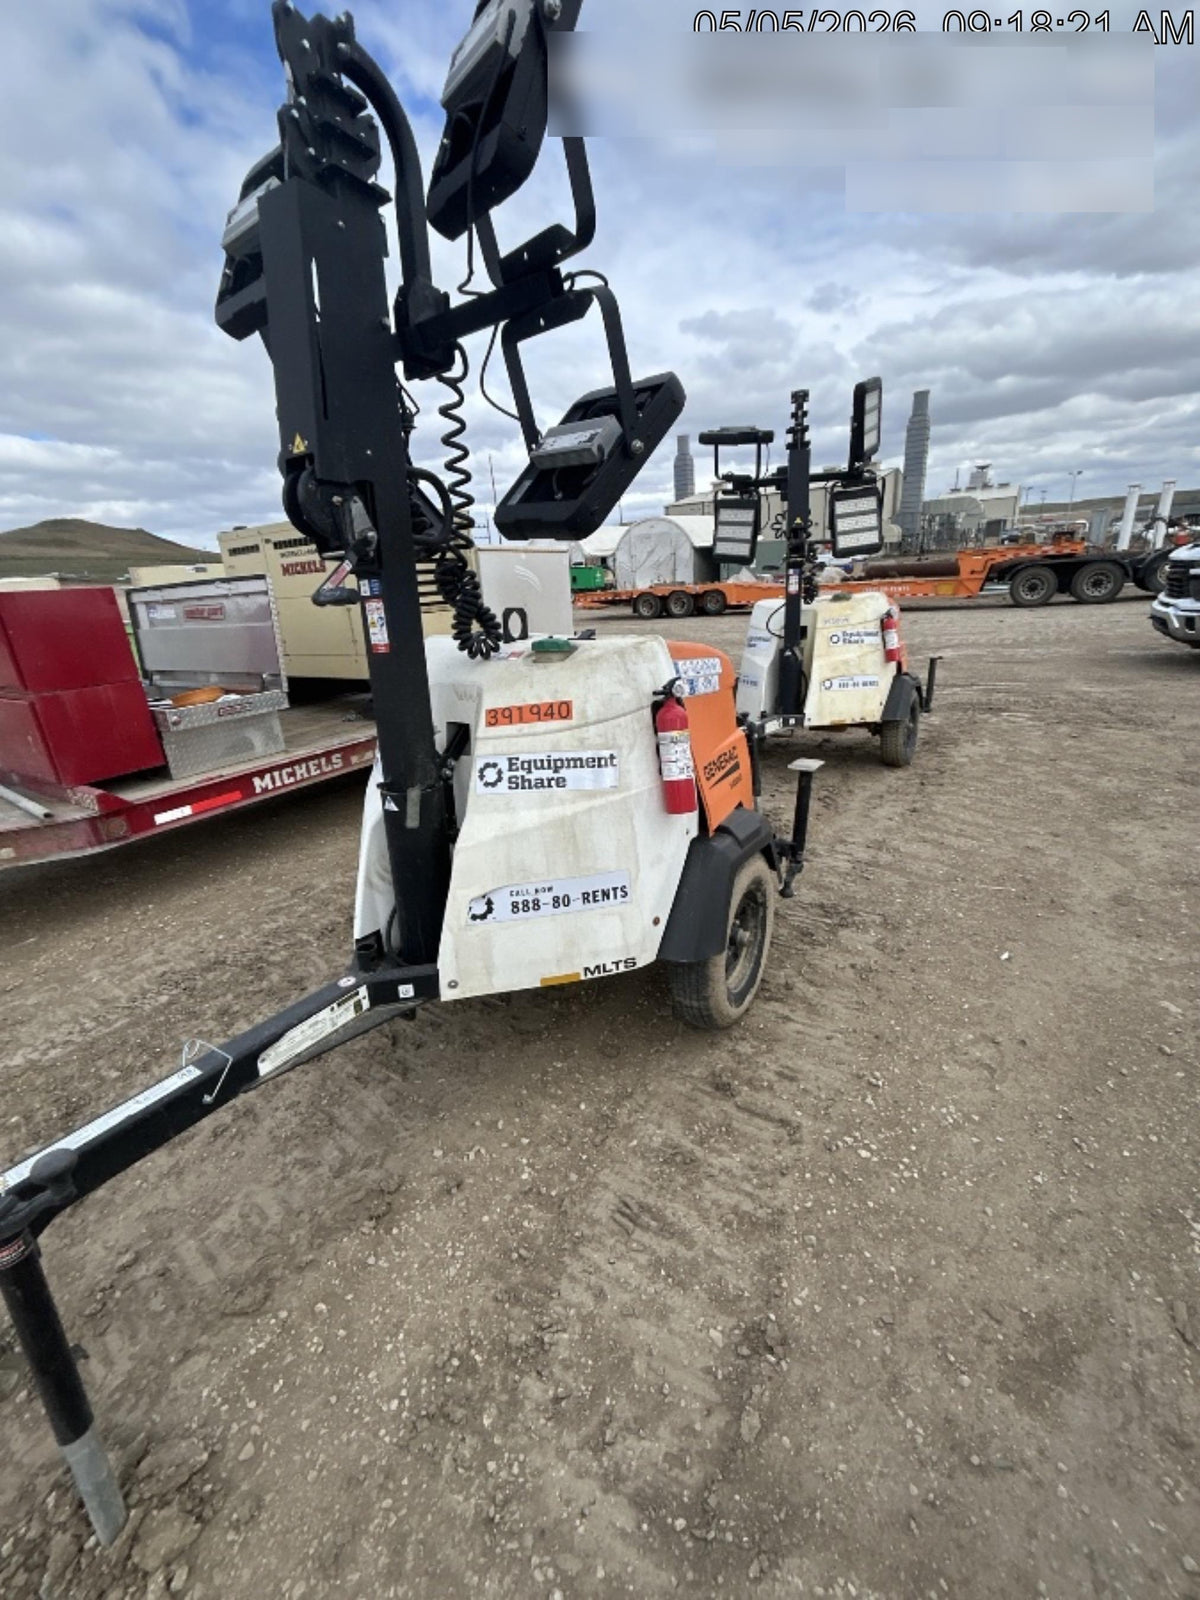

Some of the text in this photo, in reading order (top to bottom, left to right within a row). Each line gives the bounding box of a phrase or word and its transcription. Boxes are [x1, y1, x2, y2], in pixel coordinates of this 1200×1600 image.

[487, 701, 571, 726] 391940
[252, 753, 344, 794] MICHELS
[507, 753, 618, 774] Equipment
[507, 775, 567, 791] Share
[510, 884, 629, 915] 888-80-RENTS
[583, 957, 637, 977] MLTS
